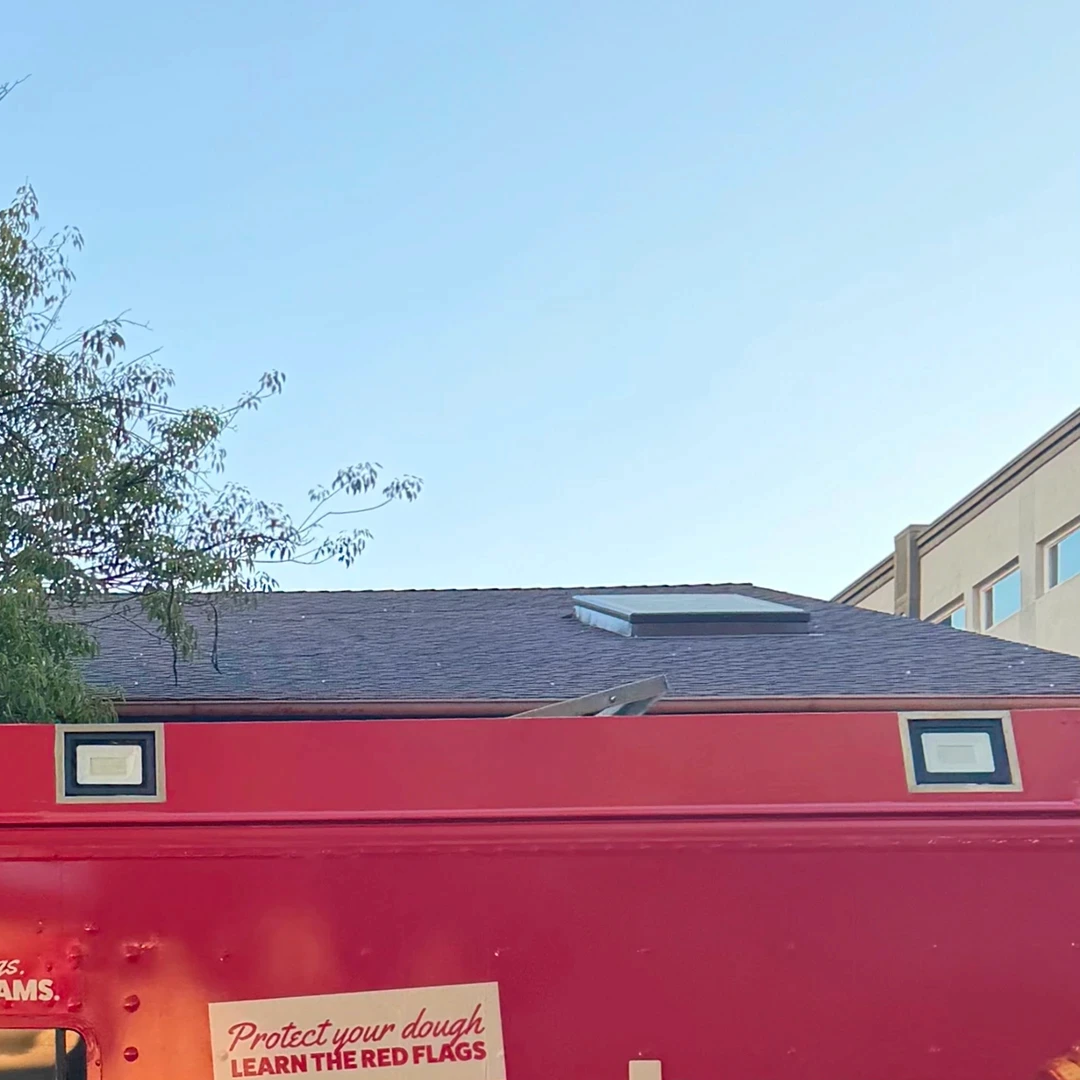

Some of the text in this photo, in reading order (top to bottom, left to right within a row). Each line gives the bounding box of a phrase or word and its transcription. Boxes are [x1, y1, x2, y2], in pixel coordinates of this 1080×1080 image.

[227, 1003, 486, 1057] Protect your dough
[231, 1041, 487, 1078] LEARN THE RED FLAGS
